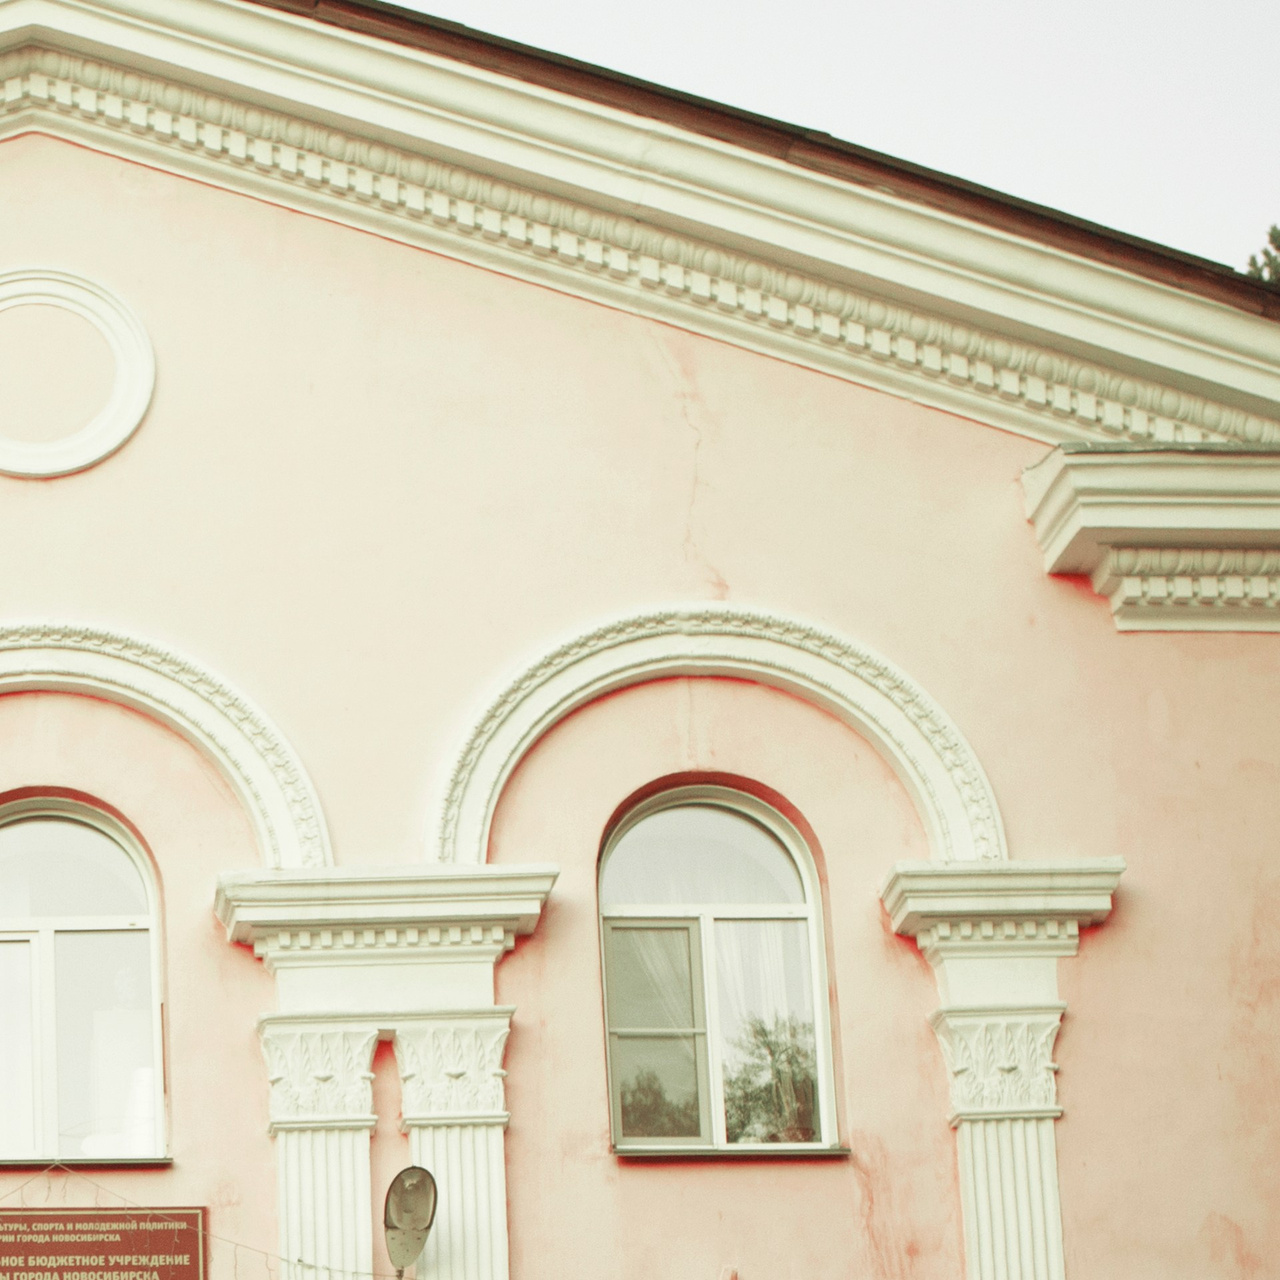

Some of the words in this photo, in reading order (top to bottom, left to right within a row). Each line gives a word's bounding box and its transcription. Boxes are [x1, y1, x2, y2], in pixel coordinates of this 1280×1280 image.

[32, 1222, 64, 1231] СПОРТА
[66, 1222, 74, 1231] И
[75, 1220, 138, 1232] МОЛОДЕЖНОЙ
[139, 1221, 187, 1231] ПОЛИТИКИ
[17, 1234, 50, 1244] ГОРОДА
[52, 1233, 121, 1243] НОВОСИБИРСКА
[28, 1255, 106, 1268] БЮДЖЕТНОЕ
[108, 1254, 191, 1267] УЧРЕЖДЕНИЕ
